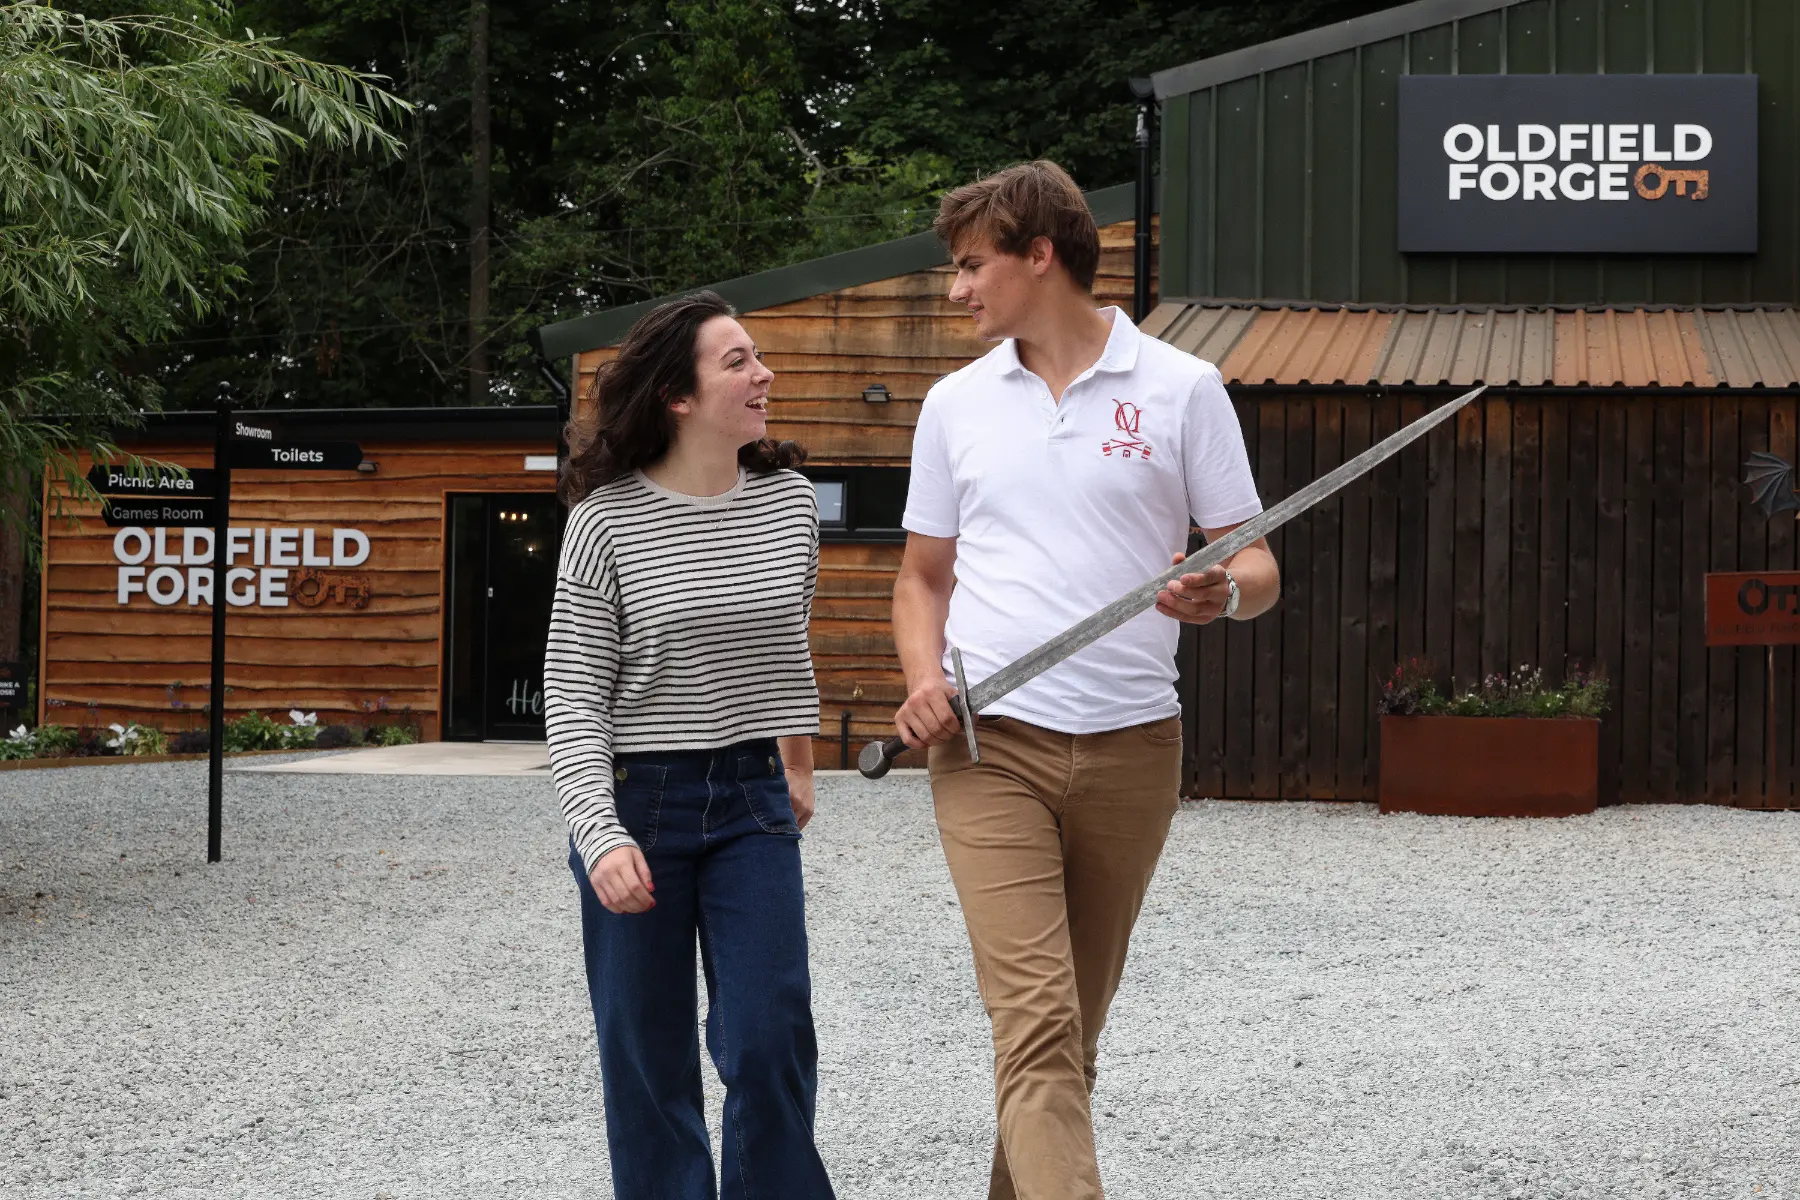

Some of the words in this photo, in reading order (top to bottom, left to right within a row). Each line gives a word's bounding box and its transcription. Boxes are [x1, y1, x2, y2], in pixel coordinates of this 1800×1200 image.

[1443, 123, 1713, 162] OLDFIELD
[1448, 162, 1630, 201] FORGE
[235, 422, 272, 441] Showroom
[271, 448, 324, 463] Toilets
[108, 473, 155, 489] Picnic
[158, 475, 194, 490] Area
[112, 507, 159, 520] Games
[162, 507, 204, 520] Room
[113, 526, 371, 567] OLDFIELD
[117, 566, 289, 607] FORGE
